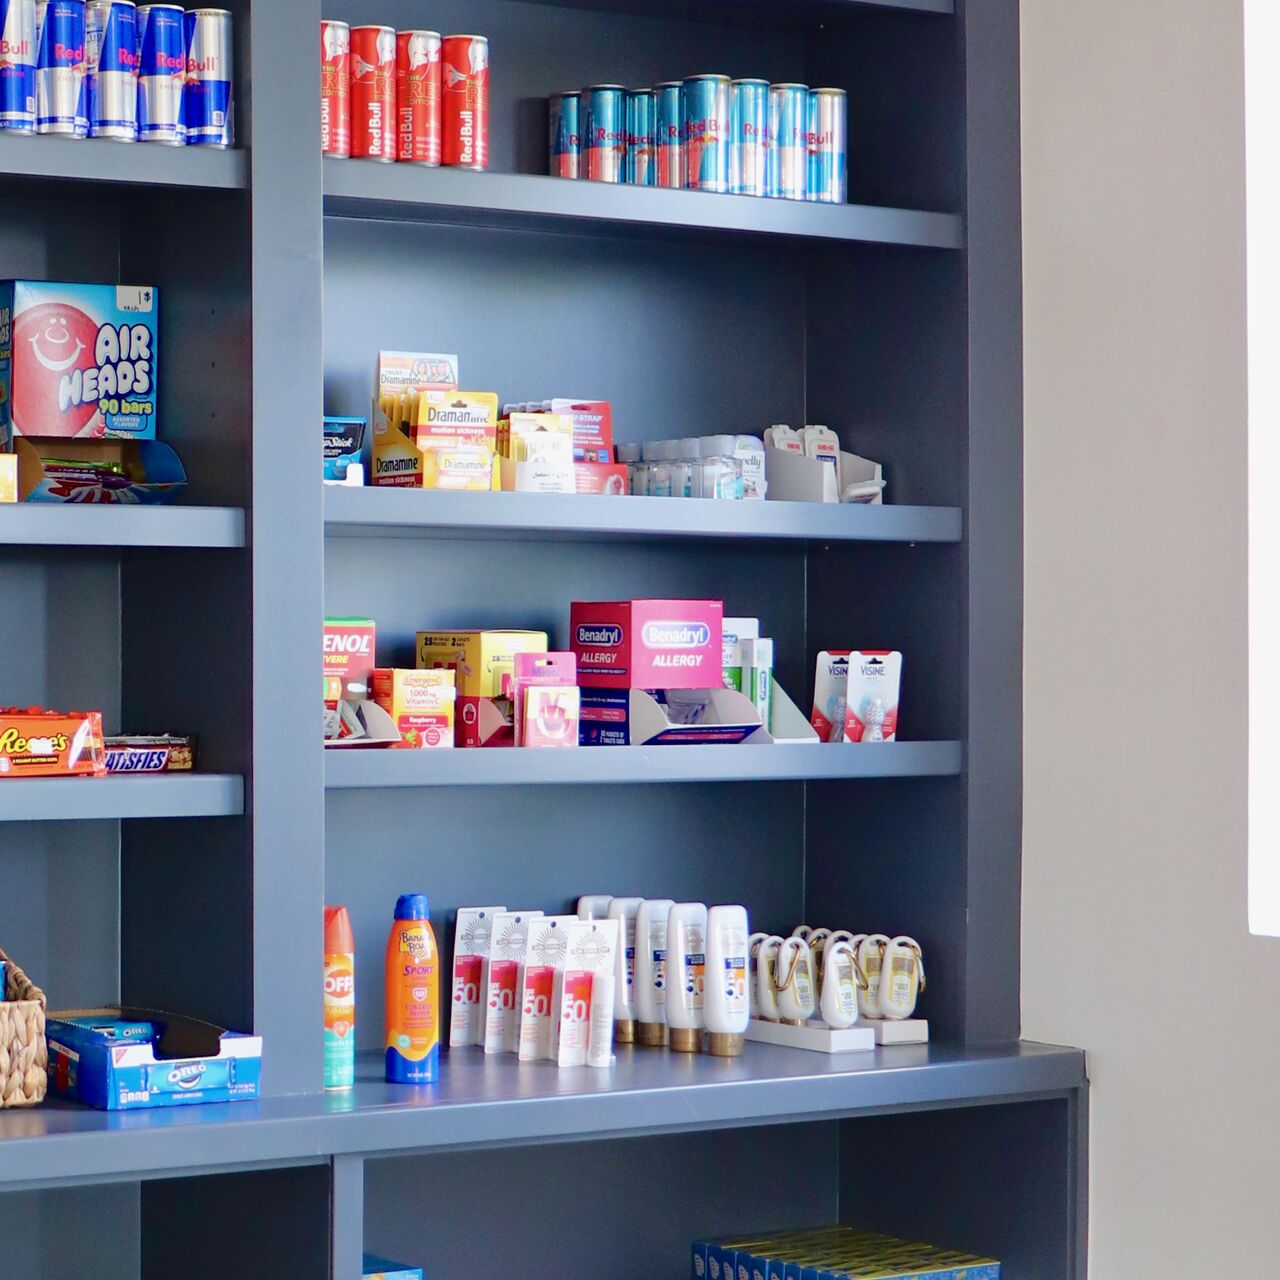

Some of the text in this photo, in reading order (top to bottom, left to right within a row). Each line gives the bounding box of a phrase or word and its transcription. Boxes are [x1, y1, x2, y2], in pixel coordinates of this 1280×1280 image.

[0, 40, 28, 55] Bull
[54, 44, 83, 61] Red
[156, 52, 183, 68] Red
[186, 57, 215, 72] Bull
[368, 102, 382, 155] Red Bull
[400, 107, 413, 159] Red Bull
[460, 111, 473, 162] Red Bull
[95, 324, 150, 366] AIR
[59, 361, 150, 411] HEADS
[381, 375, 421, 385] Dramamine
[100, 399, 152, 415] 90 bars
[376, 458, 418, 473] Dramamine
[424, 637, 433, 646] 25
[579, 628, 618, 645] Benadryl
[648, 627, 704, 646] Benadryl
[581, 653, 617, 663] ALLERGY
[653, 655, 703, 667] ALLERGY
[828, 665, 848, 676] VISIN
[861, 665, 885, 676] VISINE
[410, 690, 428, 698] 1000
[409, 717, 437, 725] Raspberry
[106, 750, 166, 770] ATISFIES
[403, 965, 433, 976] SPORT
[455, 983, 477, 1004] 50
[490, 989, 513, 1010] 50
[525, 995, 547, 1016] 50
[564, 1000, 586, 1021] 50
[123, 1027, 148, 1037] OREO
[168, 1065, 206, 1082] OREO
